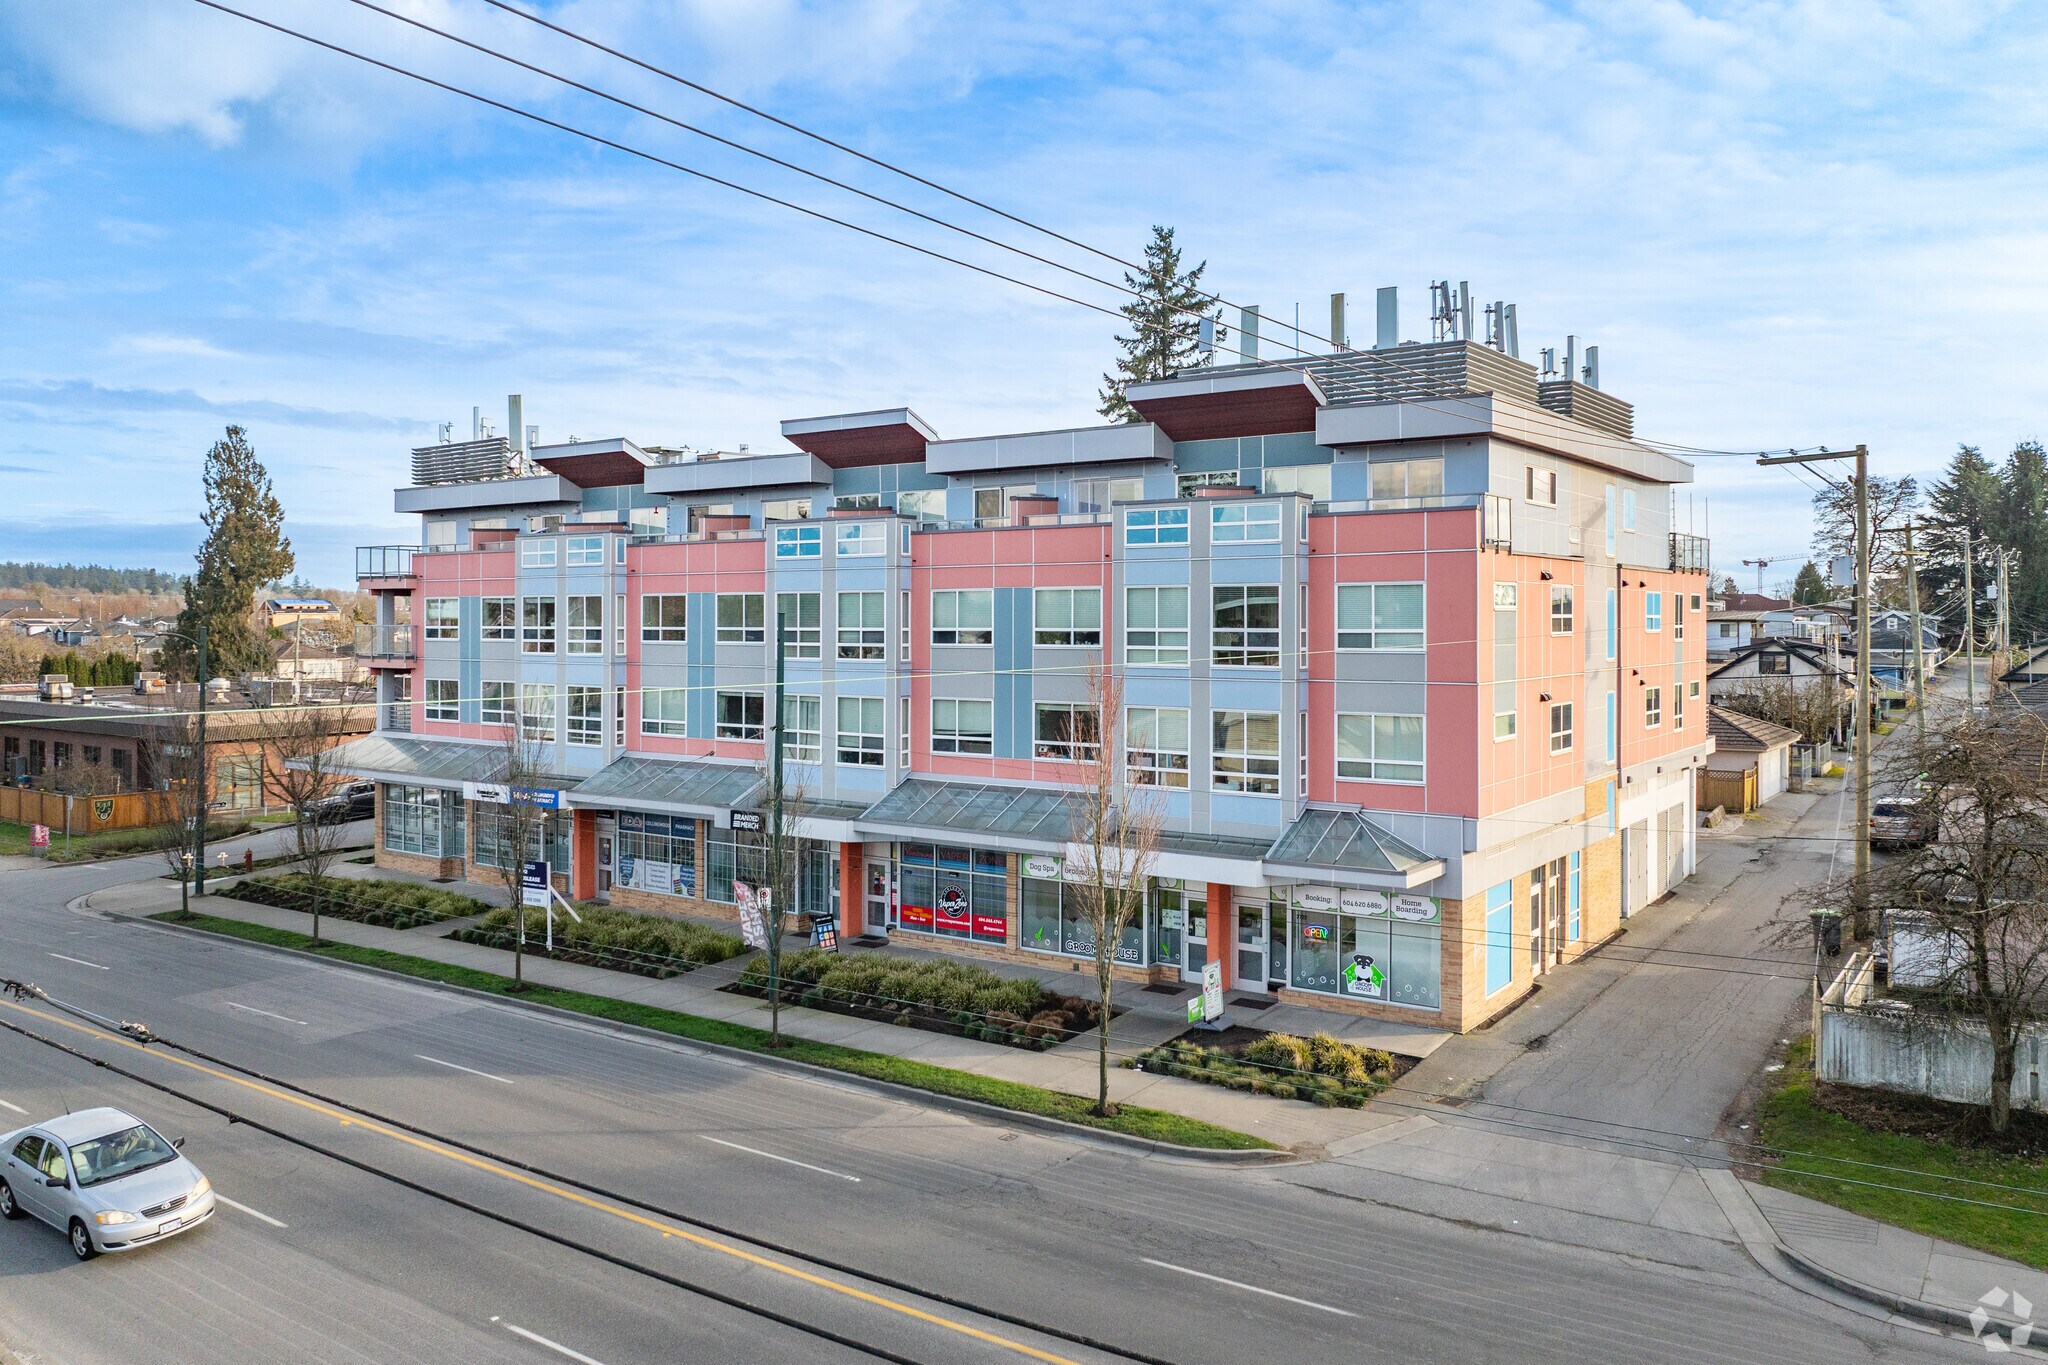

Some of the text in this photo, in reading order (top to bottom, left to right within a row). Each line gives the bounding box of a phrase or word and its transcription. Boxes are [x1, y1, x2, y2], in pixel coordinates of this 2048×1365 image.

[733, 813, 760, 821] BRANDED
[645, 820, 671, 829] COLLINGWOOD
[674, 823, 695, 831] PHARMACY
[739, 820, 759, 829] MERCH
[940, 851, 969, 862] VAPER
[979, 855, 1004, 867] ZONE
[1029, 862, 1055, 873] Dog Spa
[1305, 894, 1333, 904] Booking:
[1401, 898, 1422, 907] Home
[1395, 905, 1428, 916] Boarding
[817, 923, 833, 932] VAN
[818, 932, 834, 940] COU
[1303, 926, 1328, 939] OPEN
[820, 939, 836, 947] VER
[1354, 980, 1373, 988] GROOM
